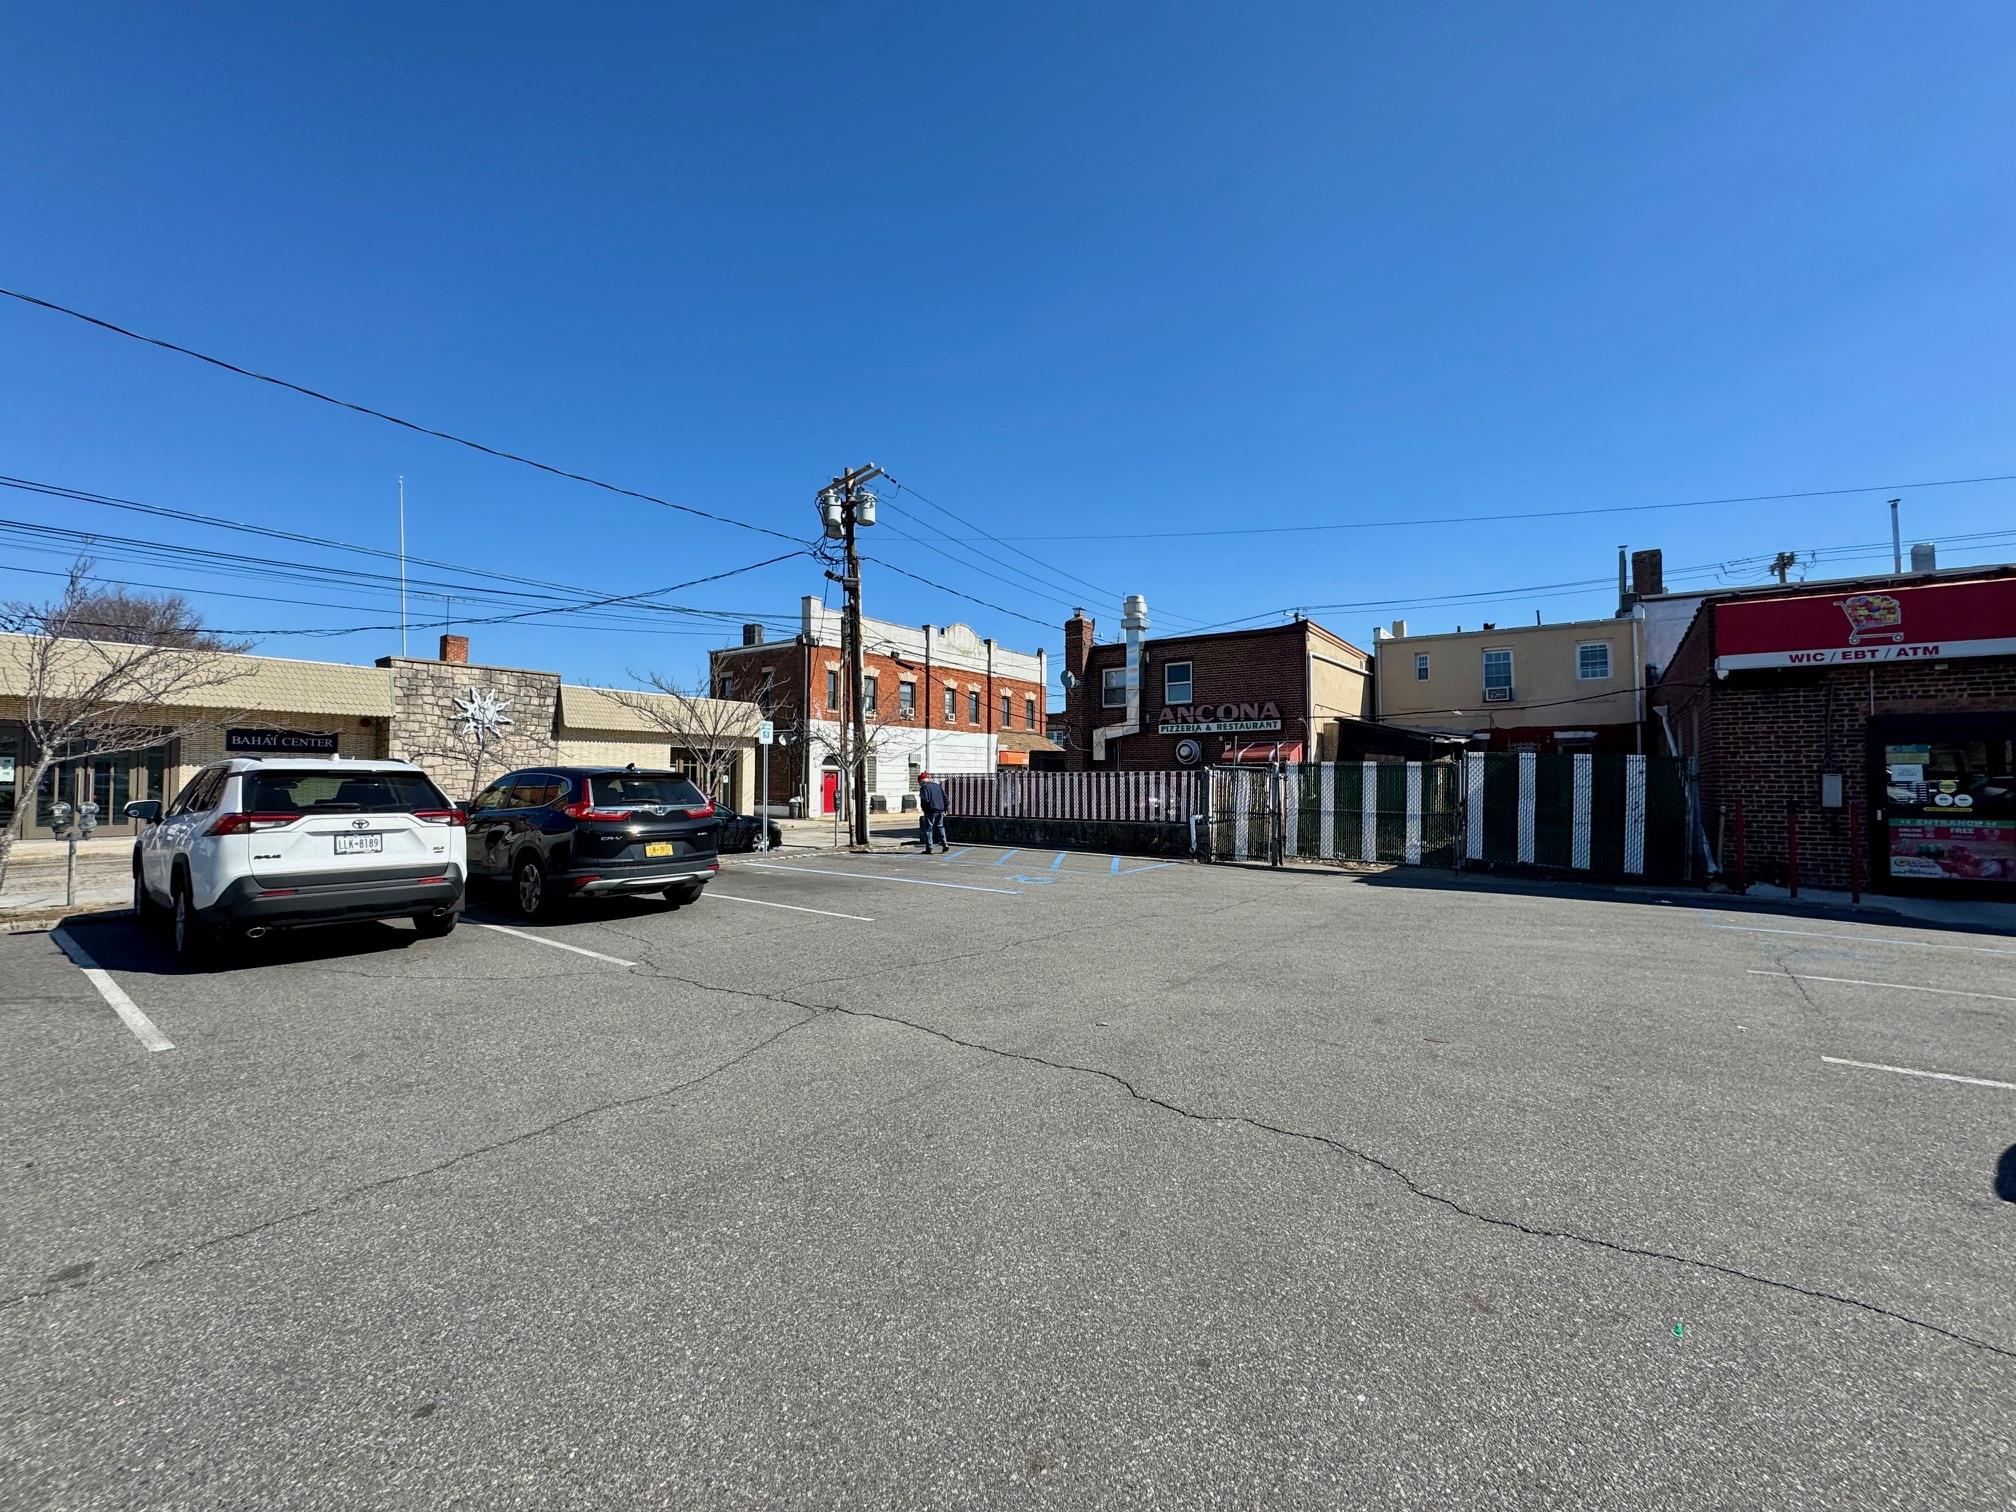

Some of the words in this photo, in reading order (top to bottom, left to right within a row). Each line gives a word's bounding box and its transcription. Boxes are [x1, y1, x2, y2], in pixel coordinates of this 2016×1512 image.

[1789, 652, 1825, 663] WIC
[1842, 649, 1879, 660] EBT
[1895, 646, 1940, 657] ATM
[1158, 701, 1281, 724] ANCONA
[1160, 723, 1202, 733] PIZZERIA
[1216, 721, 1278, 731] RESTAURANT
[281, 737, 333, 747] CENTER
